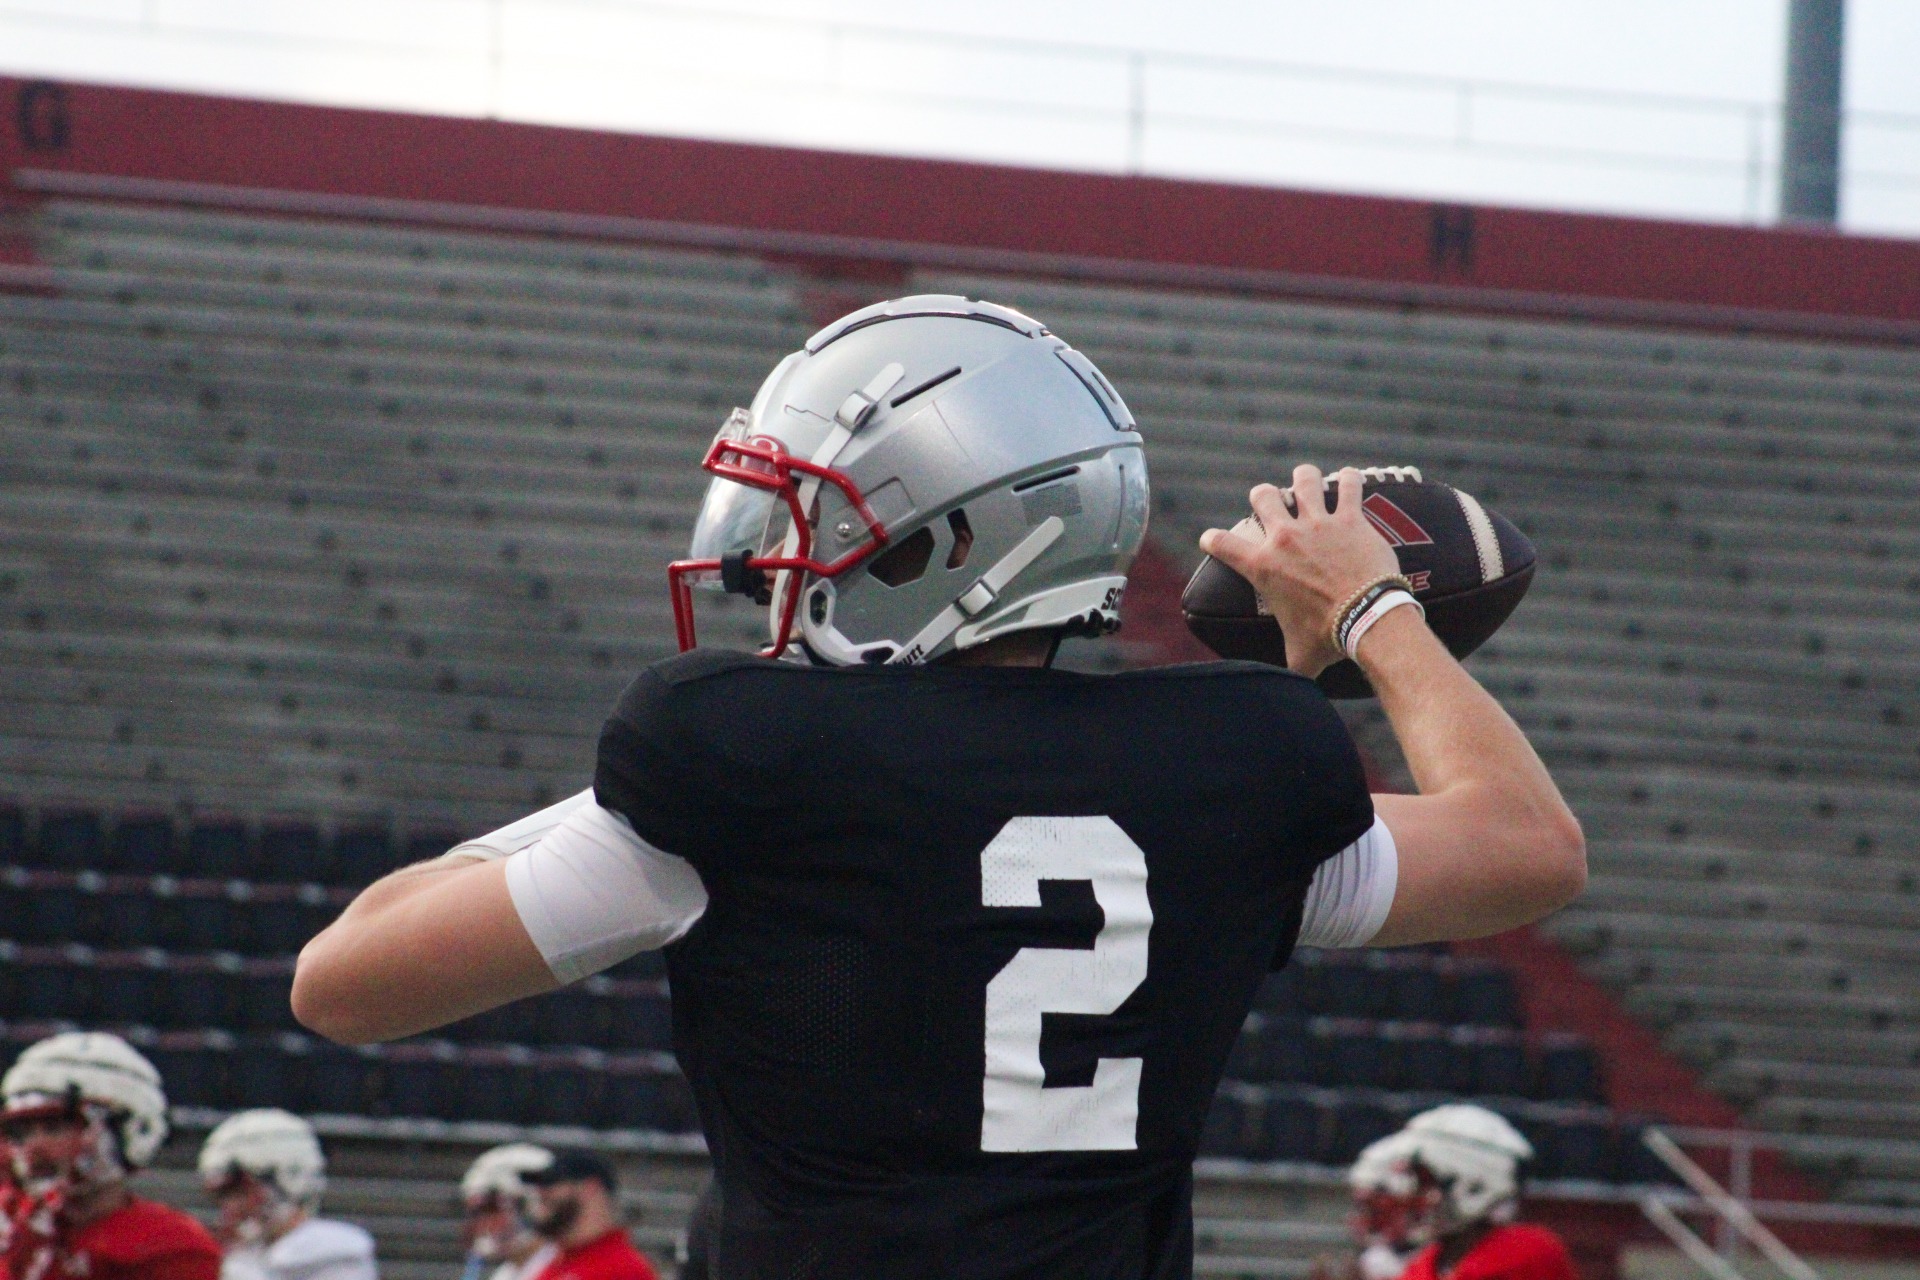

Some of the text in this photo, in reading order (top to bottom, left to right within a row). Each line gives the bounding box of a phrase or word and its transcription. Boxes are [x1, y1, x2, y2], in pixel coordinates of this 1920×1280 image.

[19, 81, 69, 151] G
[1429, 204, 1475, 274] H
[980, 815, 1154, 1153] 2
